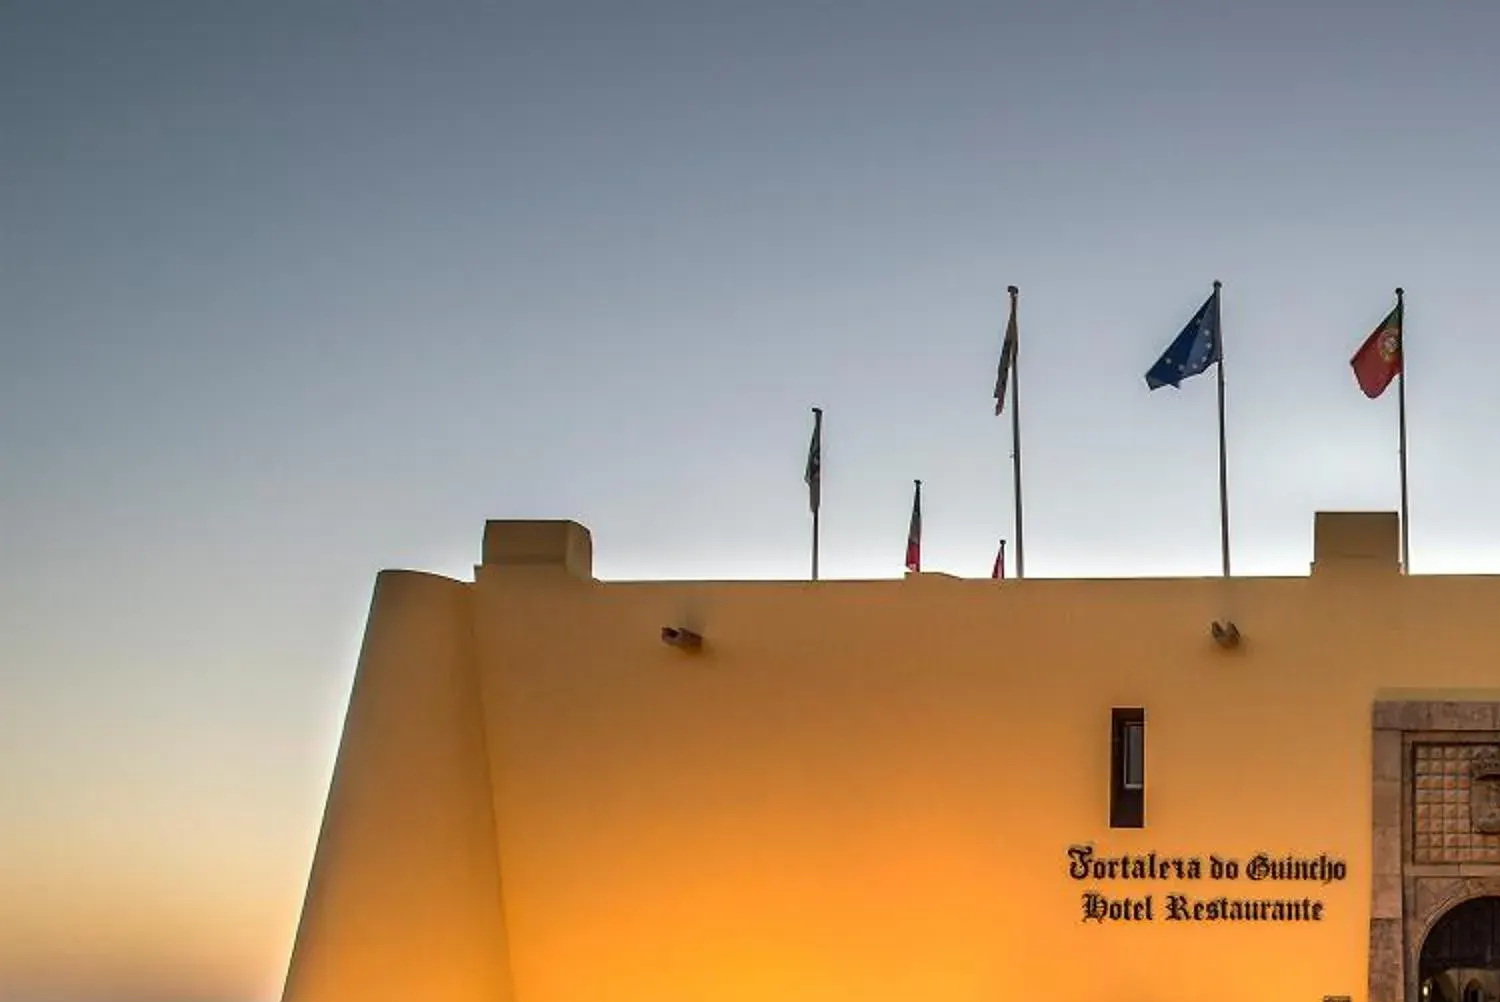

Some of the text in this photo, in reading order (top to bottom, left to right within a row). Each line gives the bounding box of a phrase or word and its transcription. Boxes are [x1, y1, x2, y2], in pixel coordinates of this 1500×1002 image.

[1209, 855, 1239, 880] do
[1246, 853, 1346, 886] Guincho
[1082, 893, 1324, 923] Hotel Restaurante
